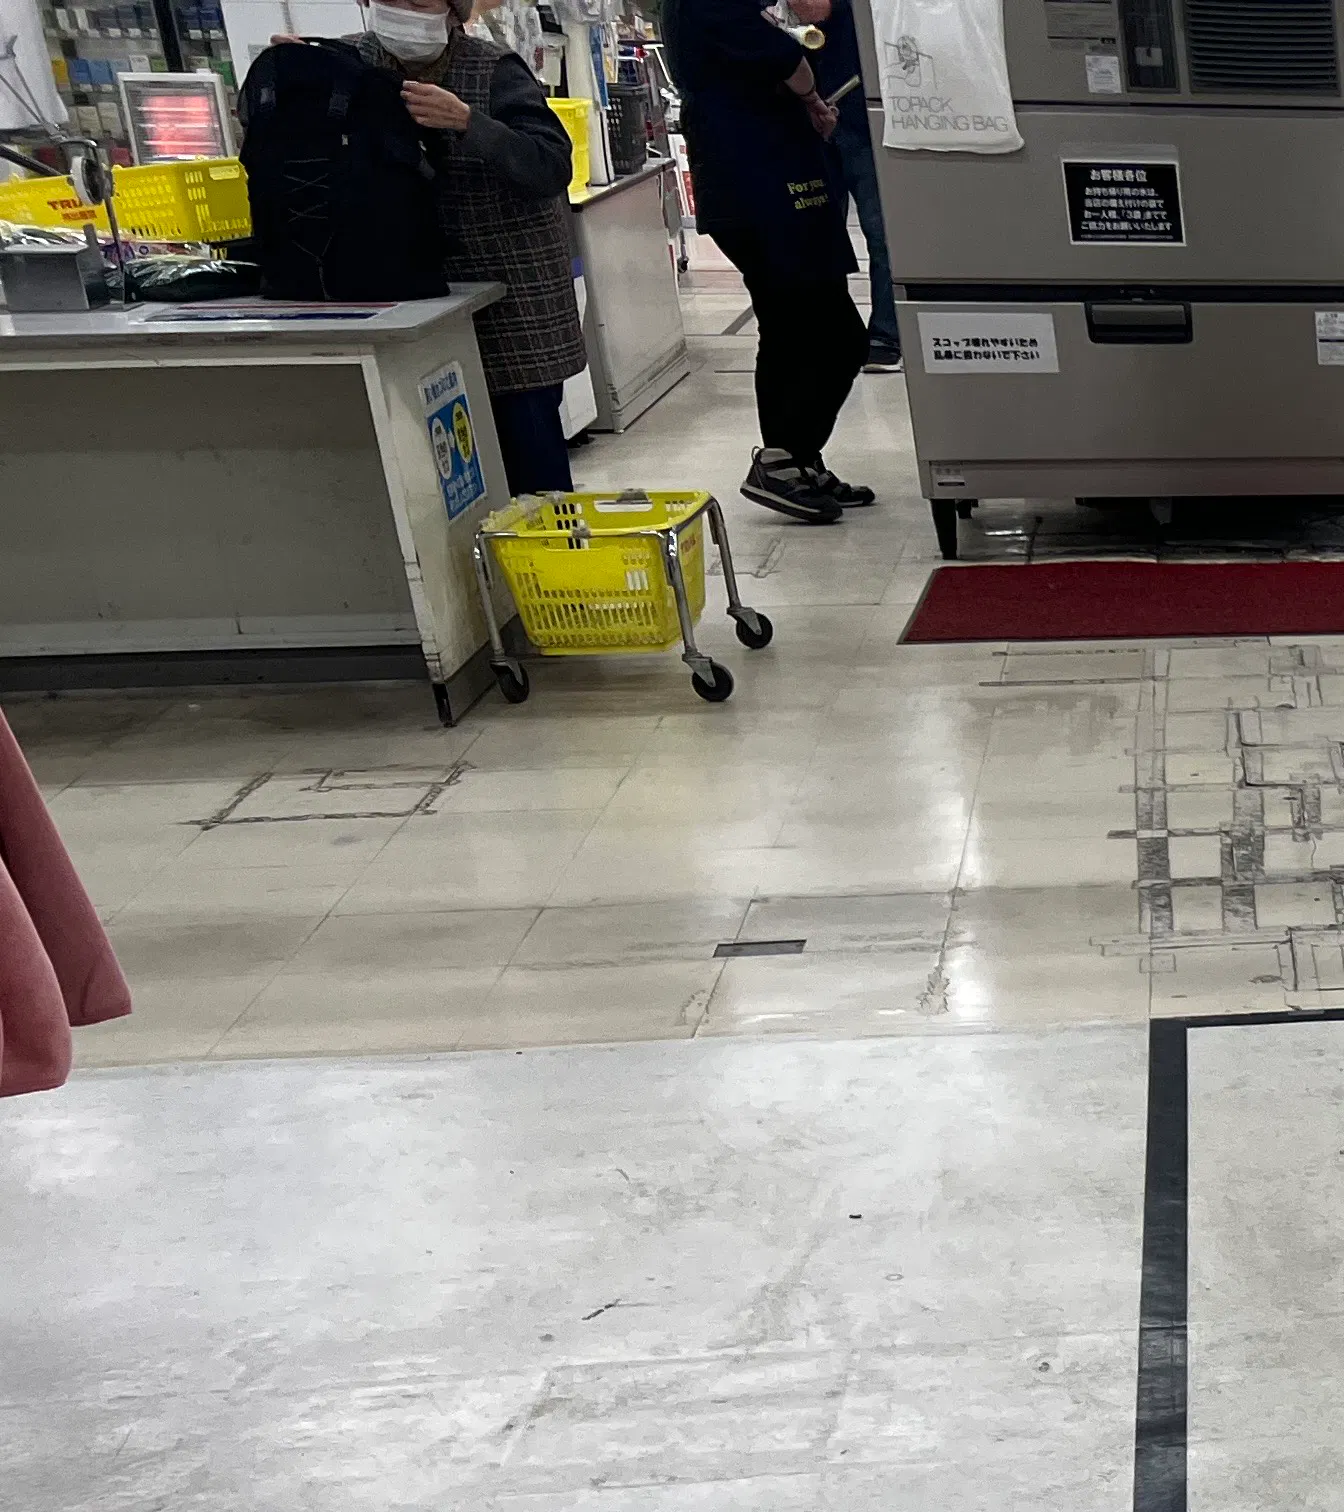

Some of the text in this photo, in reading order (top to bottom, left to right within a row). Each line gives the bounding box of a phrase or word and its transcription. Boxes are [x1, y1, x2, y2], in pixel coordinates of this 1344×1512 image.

[888, 96, 954, 113] TOPACK
[891, 114, 1009, 132] HANGING BAG
